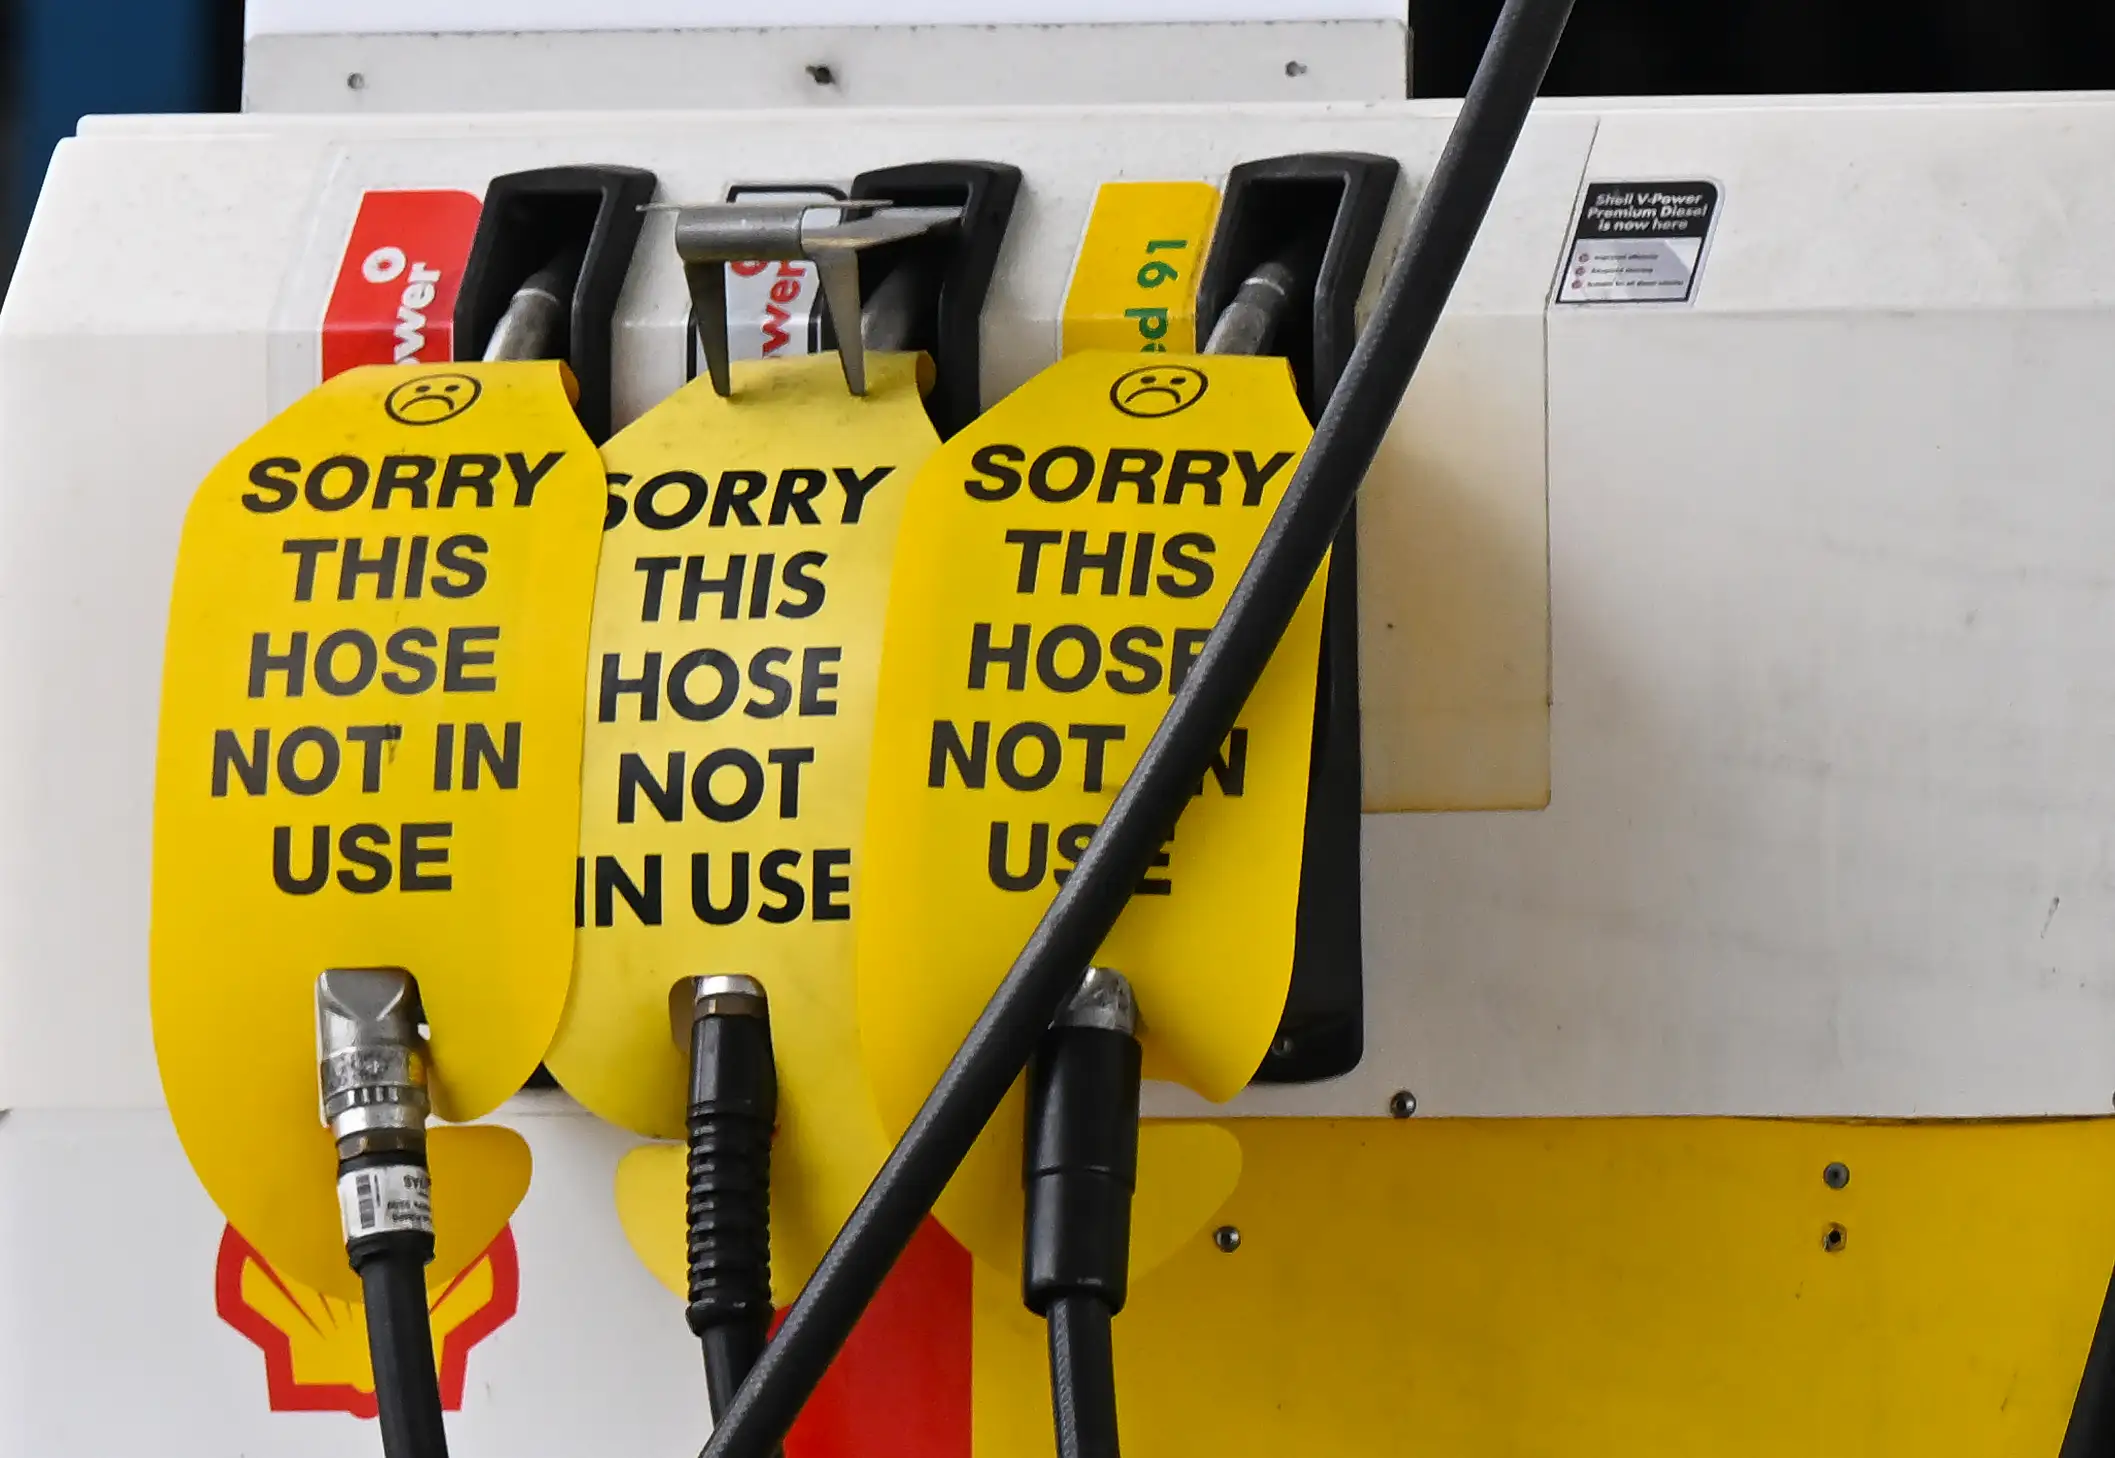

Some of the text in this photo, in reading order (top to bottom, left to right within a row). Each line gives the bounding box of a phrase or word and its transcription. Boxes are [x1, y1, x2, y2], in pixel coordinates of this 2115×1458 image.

[1587, 203, 1708, 220] Premium Diesel
[1596, 193, 1634, 206] Shell
[1613, 219, 1651, 232] now
[1652, 217, 1688, 231] here
[1137, 240, 1187, 289] 91
[394, 262, 441, 364] wer
[762, 259, 806, 358] wer
[242, 452, 565, 512] SORRY
[604, 467, 895, 531] SORRY
[965, 444, 1294, 506] SORRY
[283, 534, 488, 600] THIS
[635, 551, 827, 621] THIS
[1005, 530, 1215, 598] THIS
[249, 627, 499, 697] HOSE
[599, 647, 841, 722] HOSE
[212, 723, 521, 796] NOT IN
[618, 748, 814, 823] NOT
[928, 720, 1125, 793] NOT
[273, 823, 452, 895] USE
[692, 849, 850, 925] USE
